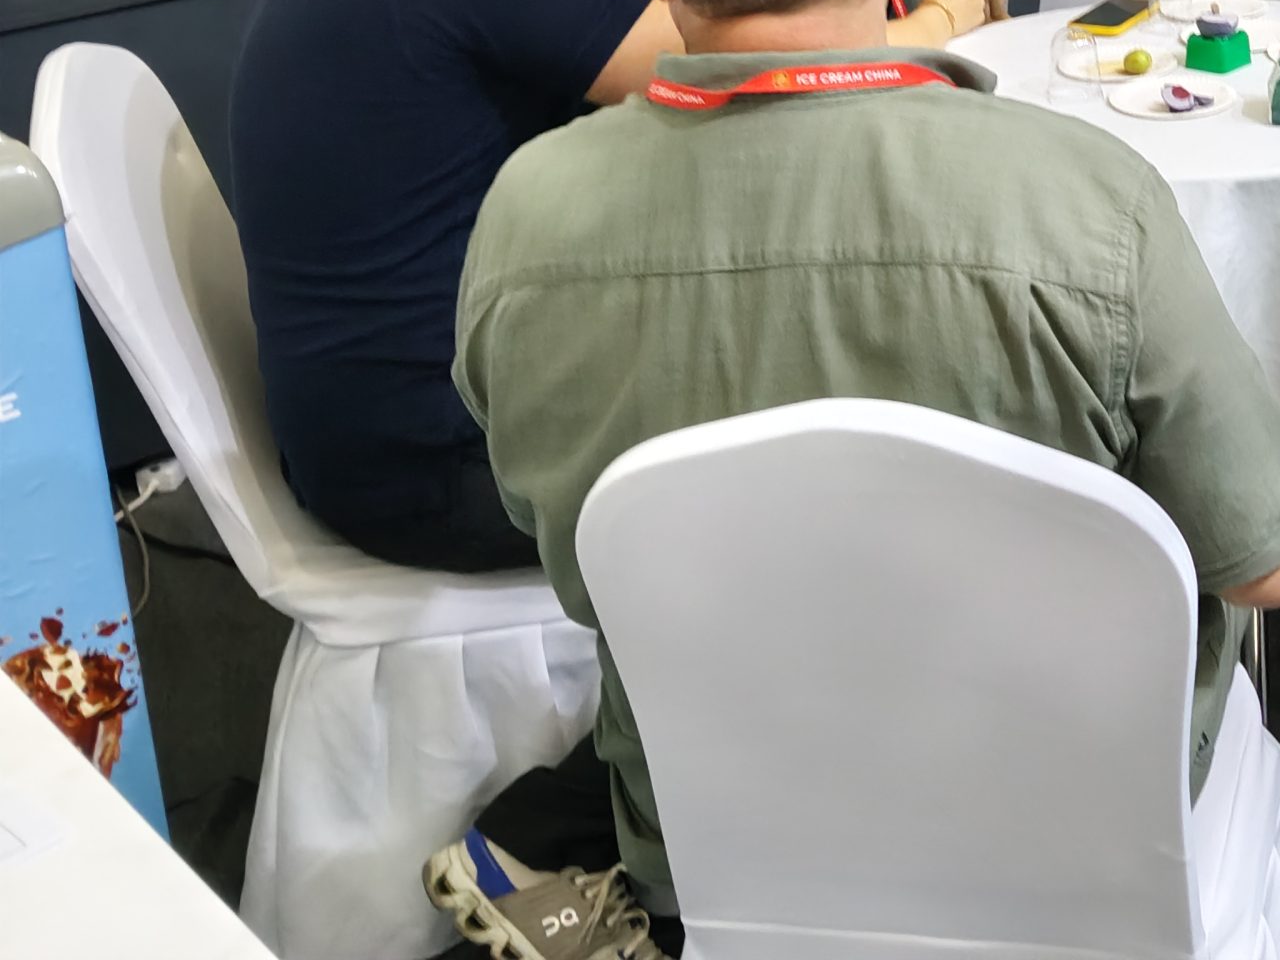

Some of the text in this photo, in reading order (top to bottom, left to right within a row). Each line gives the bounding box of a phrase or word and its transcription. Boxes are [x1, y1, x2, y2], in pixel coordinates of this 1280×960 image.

[796, 68, 902, 85] ICE CREAM CHINA
